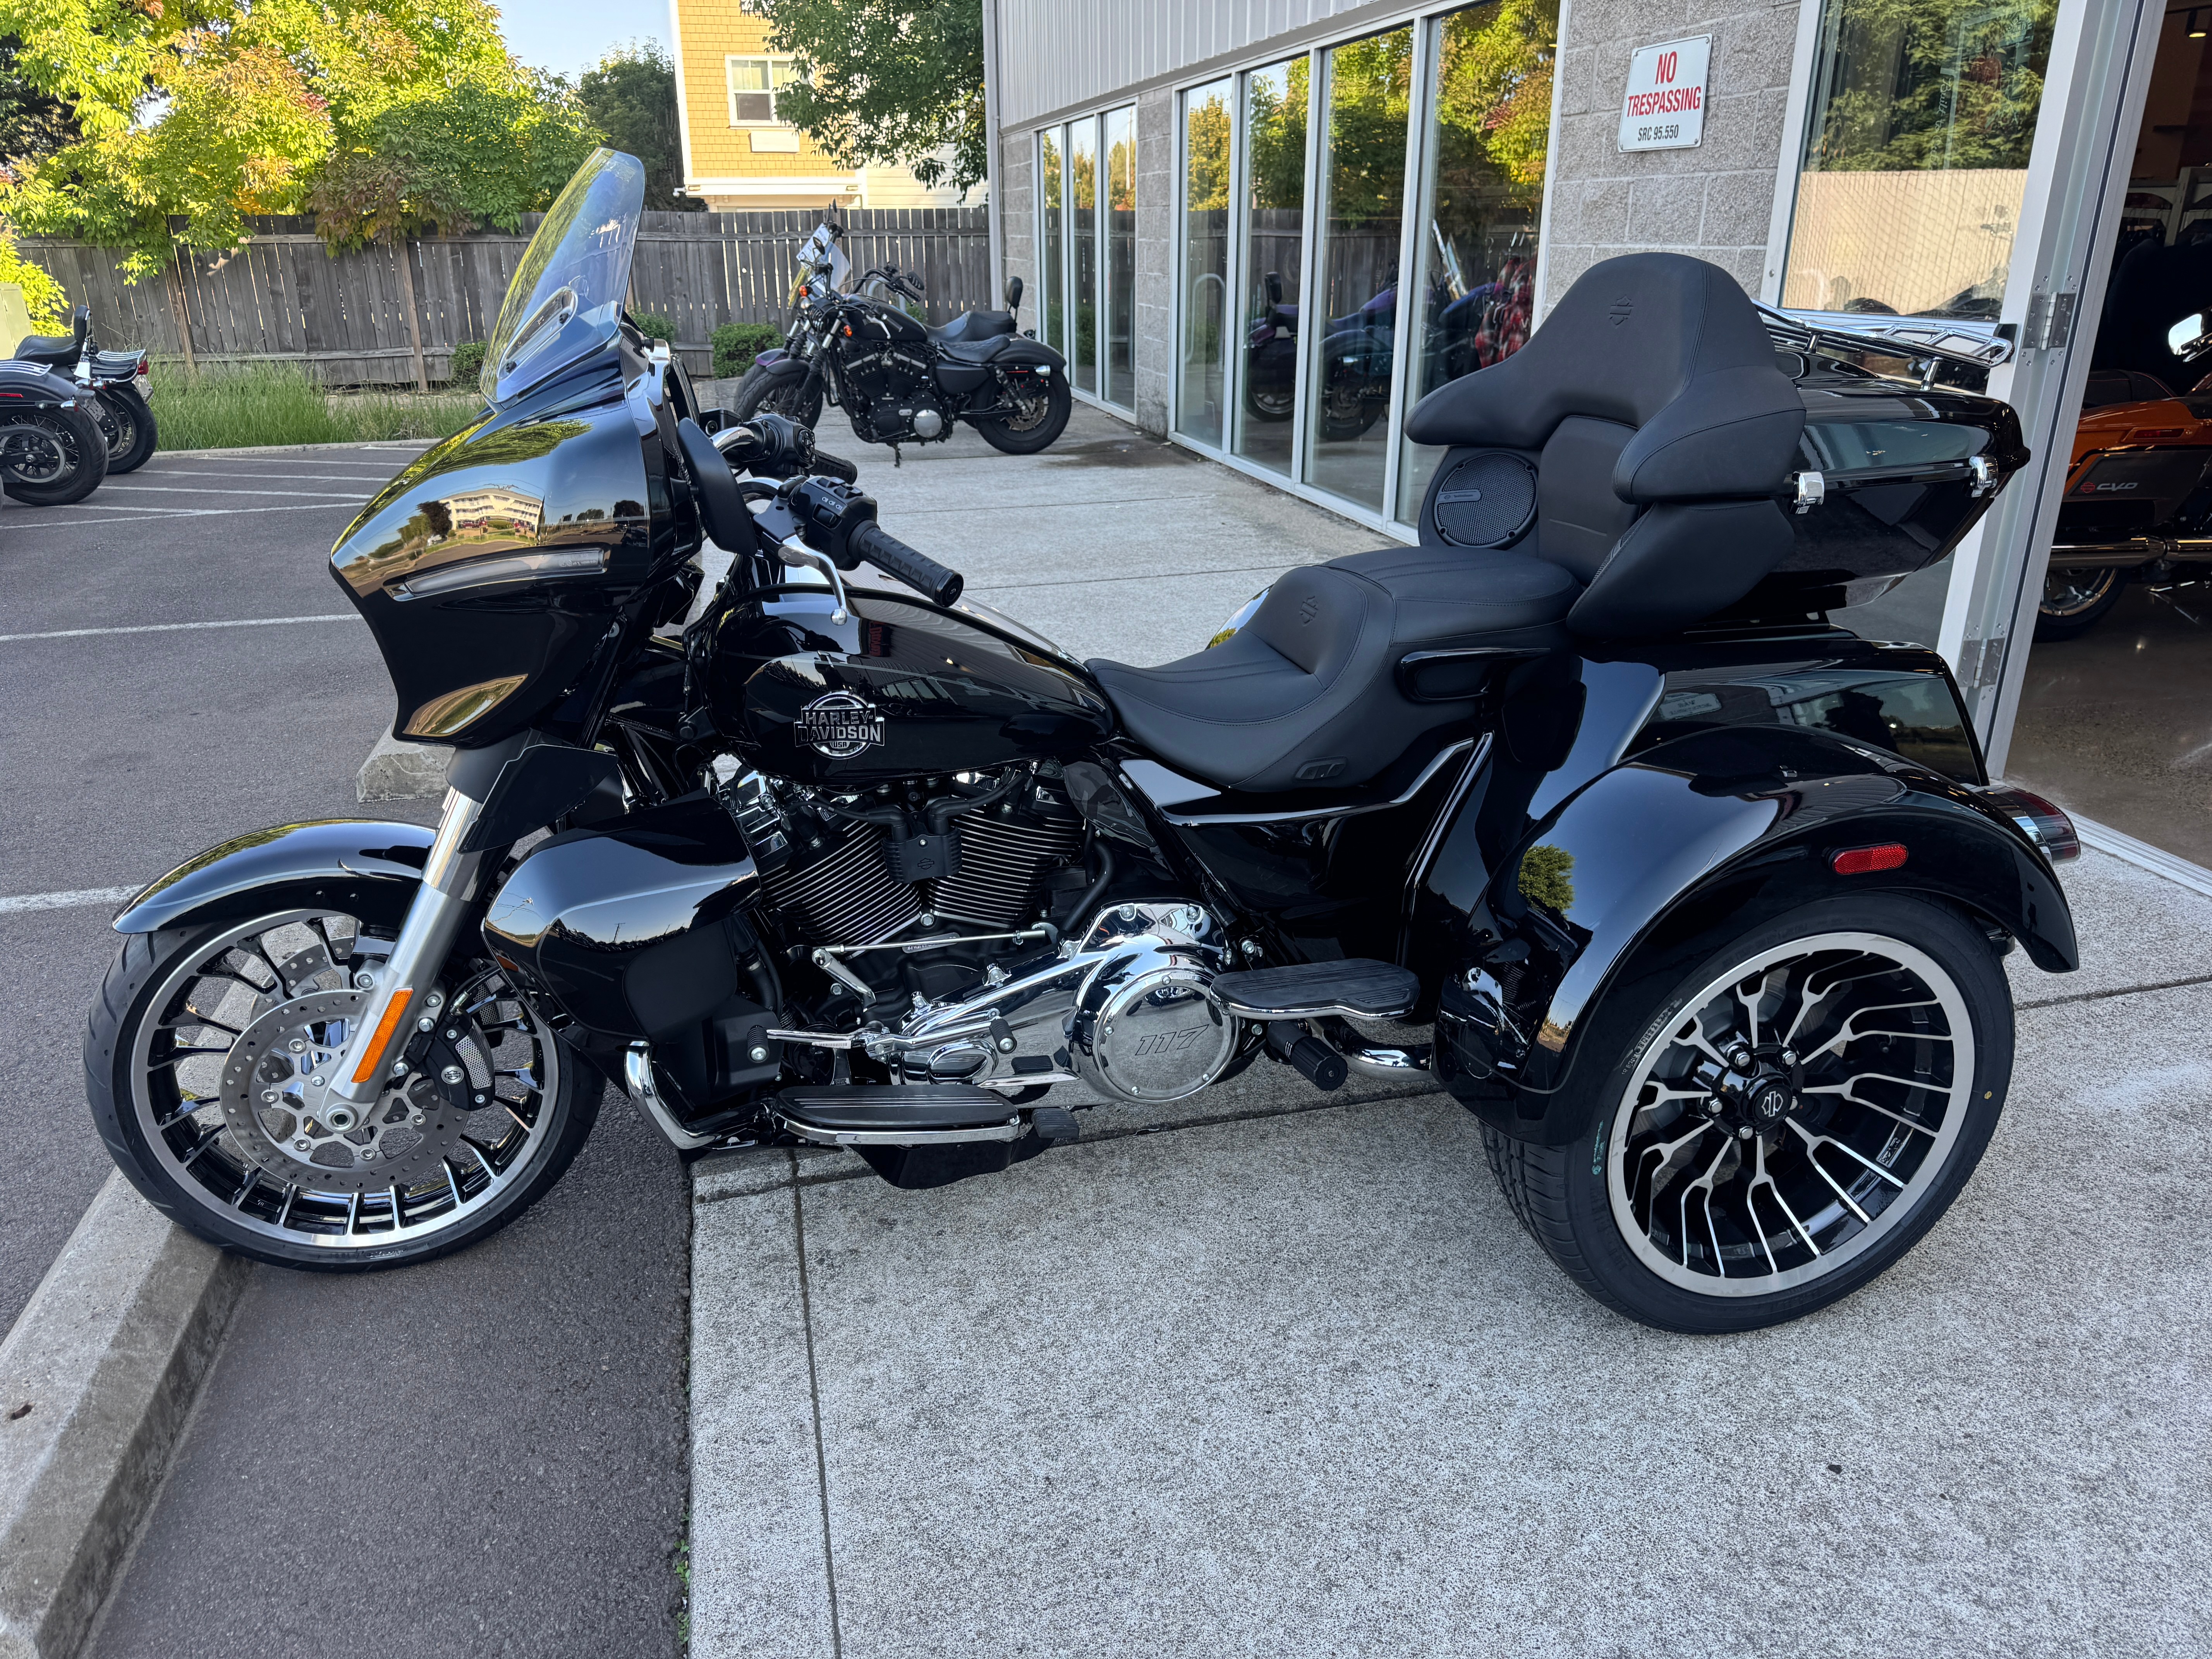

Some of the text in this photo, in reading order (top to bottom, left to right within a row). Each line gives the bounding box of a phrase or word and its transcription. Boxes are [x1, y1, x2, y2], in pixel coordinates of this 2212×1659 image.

[1655, 51, 1677, 84] NO
[1627, 86, 1701, 117] TRESPASSING
[1638, 124, 1679, 141] SRC 95.550
[2097, 483, 2138, 491] CVO
[798, 725, 881, 742] DAVIDSON
[1135, 1024, 1209, 1056] 117
